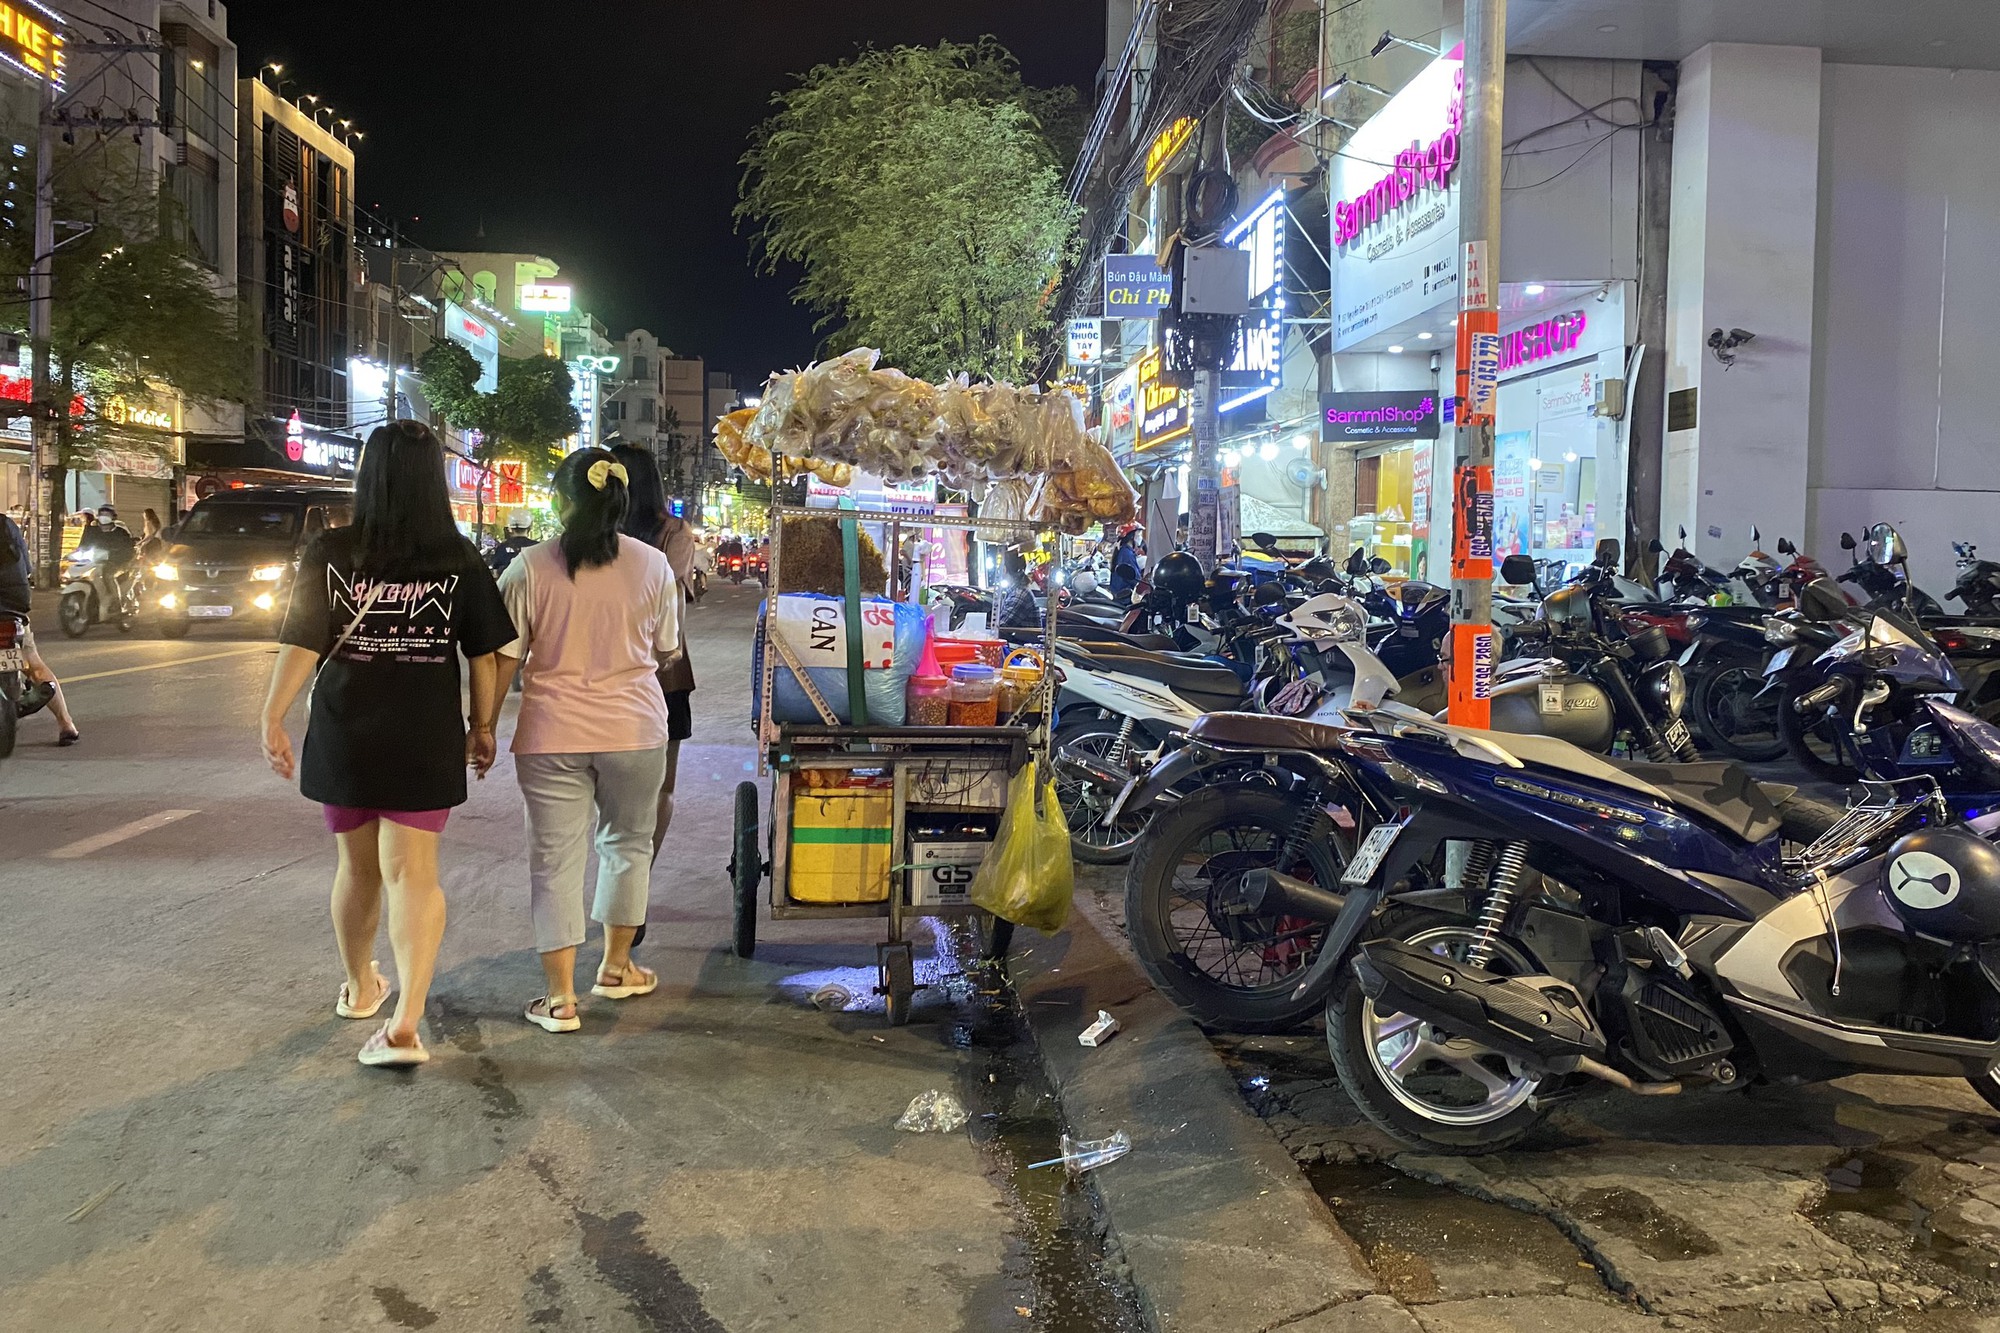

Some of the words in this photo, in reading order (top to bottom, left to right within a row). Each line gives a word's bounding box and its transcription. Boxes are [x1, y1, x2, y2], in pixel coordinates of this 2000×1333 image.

[1335, 128, 1458, 245] SammiShop
[284, 245, 292, 322] aka
[1107, 271, 1126, 282] Bún
[1128, 271, 1147, 284] Đậu
[1109, 287, 1141, 305] Chí
[1327, 406, 1424, 424] SammiShop
[1344, 426, 1374, 434] Cosmetic
[1375, 425, 1381, 434] &
[1382, 425, 1418, 433] Accessories
[329, 443, 354, 462] HOUSE
[810, 606, 838, 652] CAN
[932, 866, 973, 884] GS
